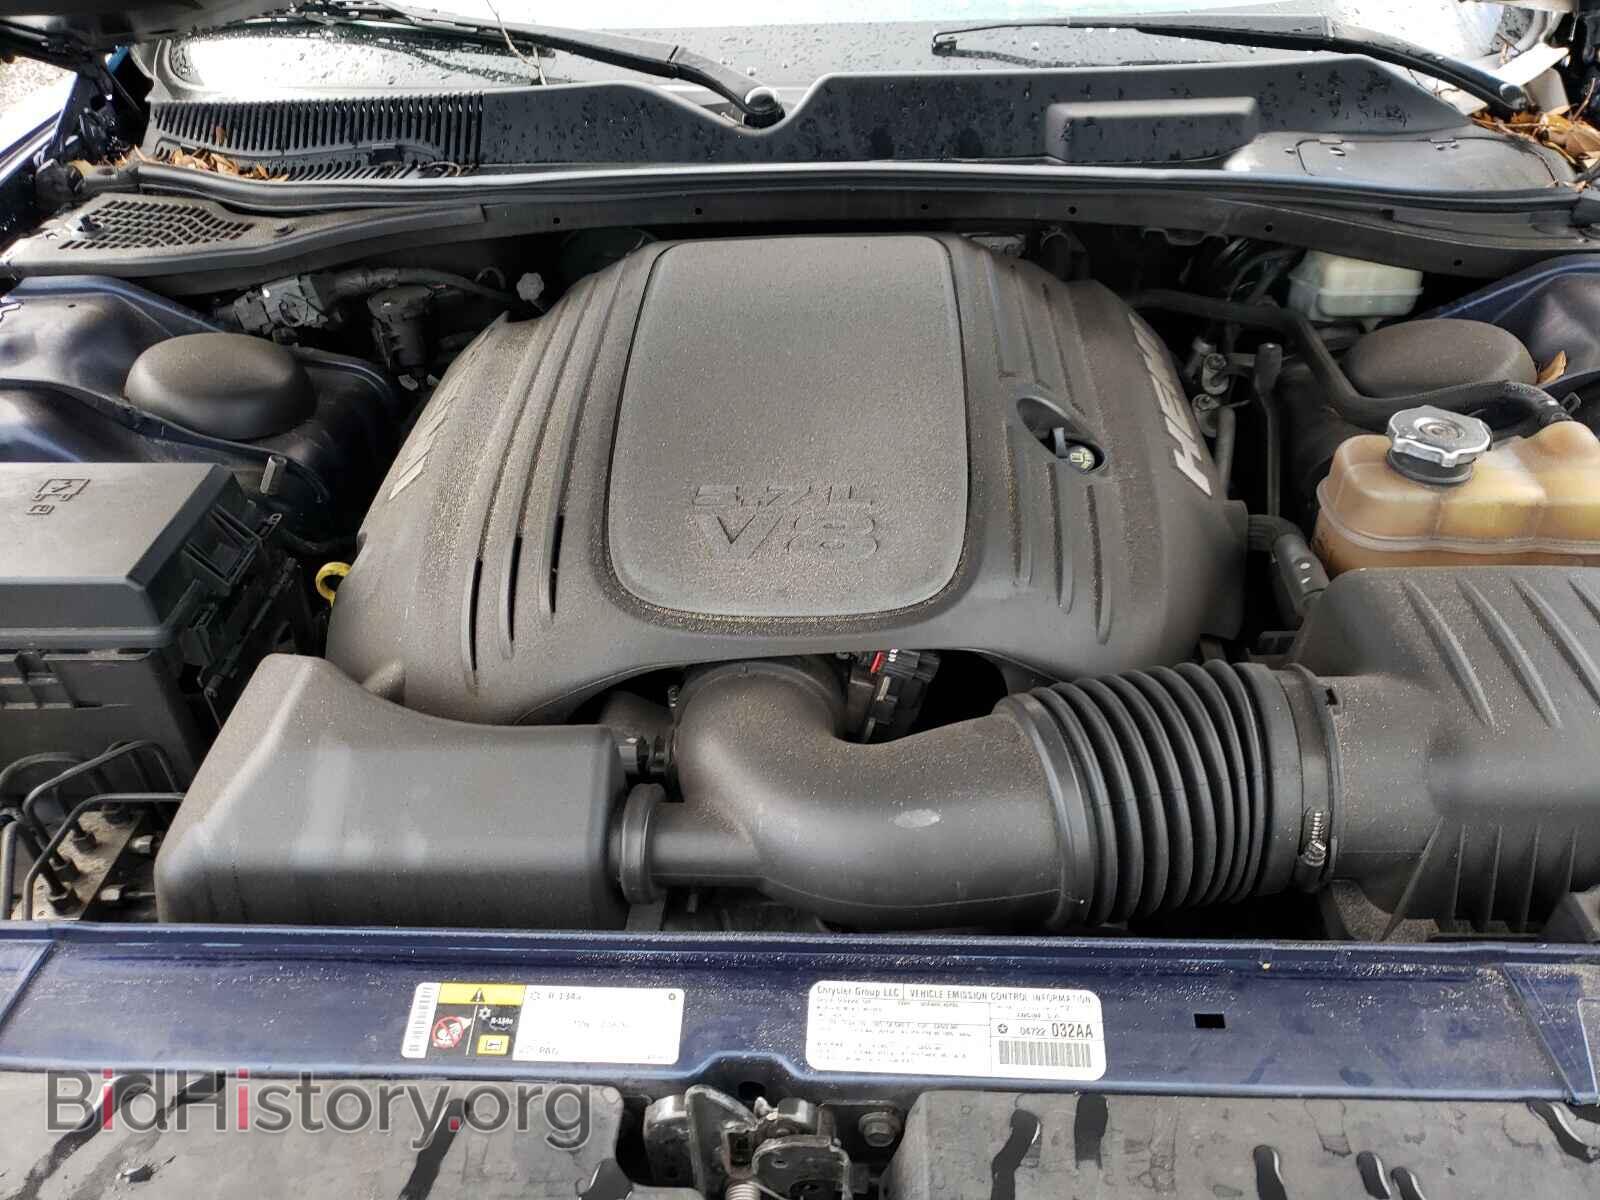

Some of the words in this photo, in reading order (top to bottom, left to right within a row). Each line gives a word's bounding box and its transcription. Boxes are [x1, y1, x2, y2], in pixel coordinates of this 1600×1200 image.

[692, 511, 879, 560] V8
[855, 986, 881, 998] Group
[883, 987, 900, 998] LLC
[910, 988, 944, 999] VEHICLE
[947, 990, 988, 1001] EMISSION
[990, 991, 1028, 1002] CONTROL
[1032, 992, 1092, 1004] INFORMATION
[1051, 1022, 1094, 1039] 032AA
